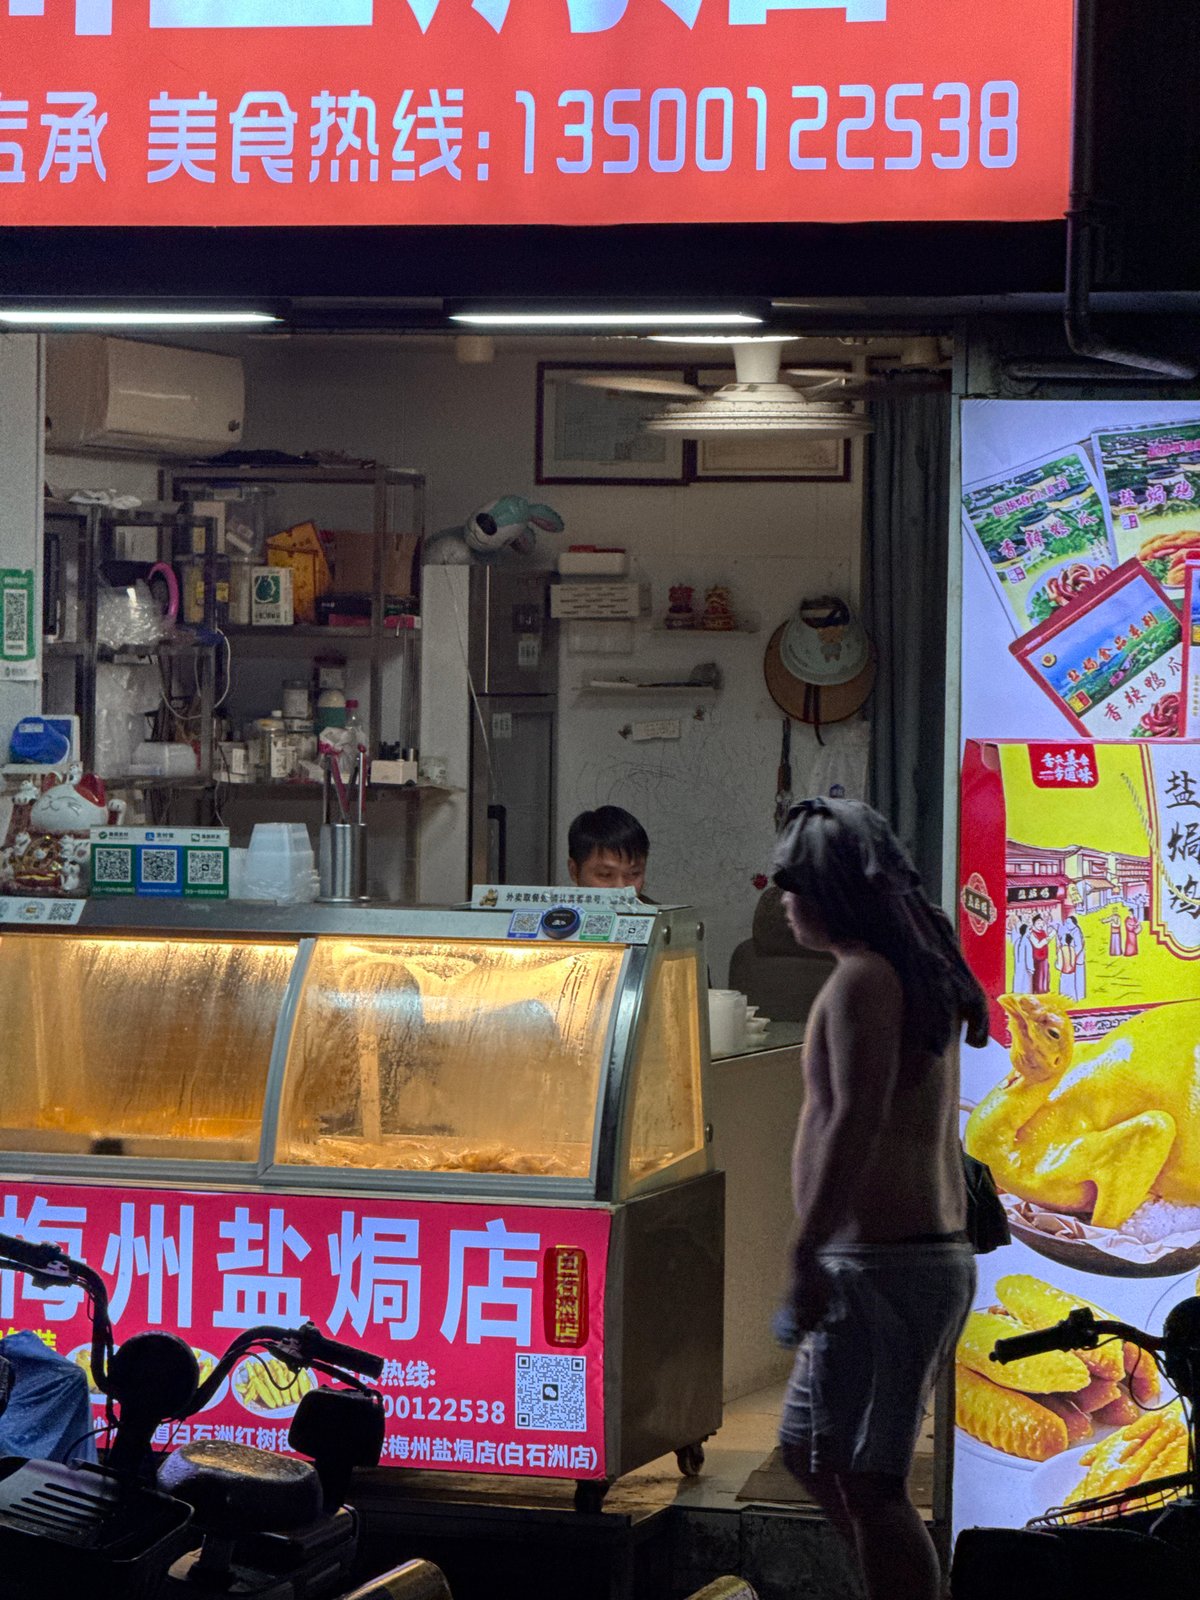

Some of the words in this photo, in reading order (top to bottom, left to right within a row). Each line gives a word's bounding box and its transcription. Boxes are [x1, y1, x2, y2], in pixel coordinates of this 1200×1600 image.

[1066, 611, 1158, 682] 盐焗食品系列
[1104, 656, 1184, 723] 香辣鸭爪
[1165, 770, 1200, 919] 盐焗鸡
[0, 1195, 540, 1347] 梅州盐焗店
